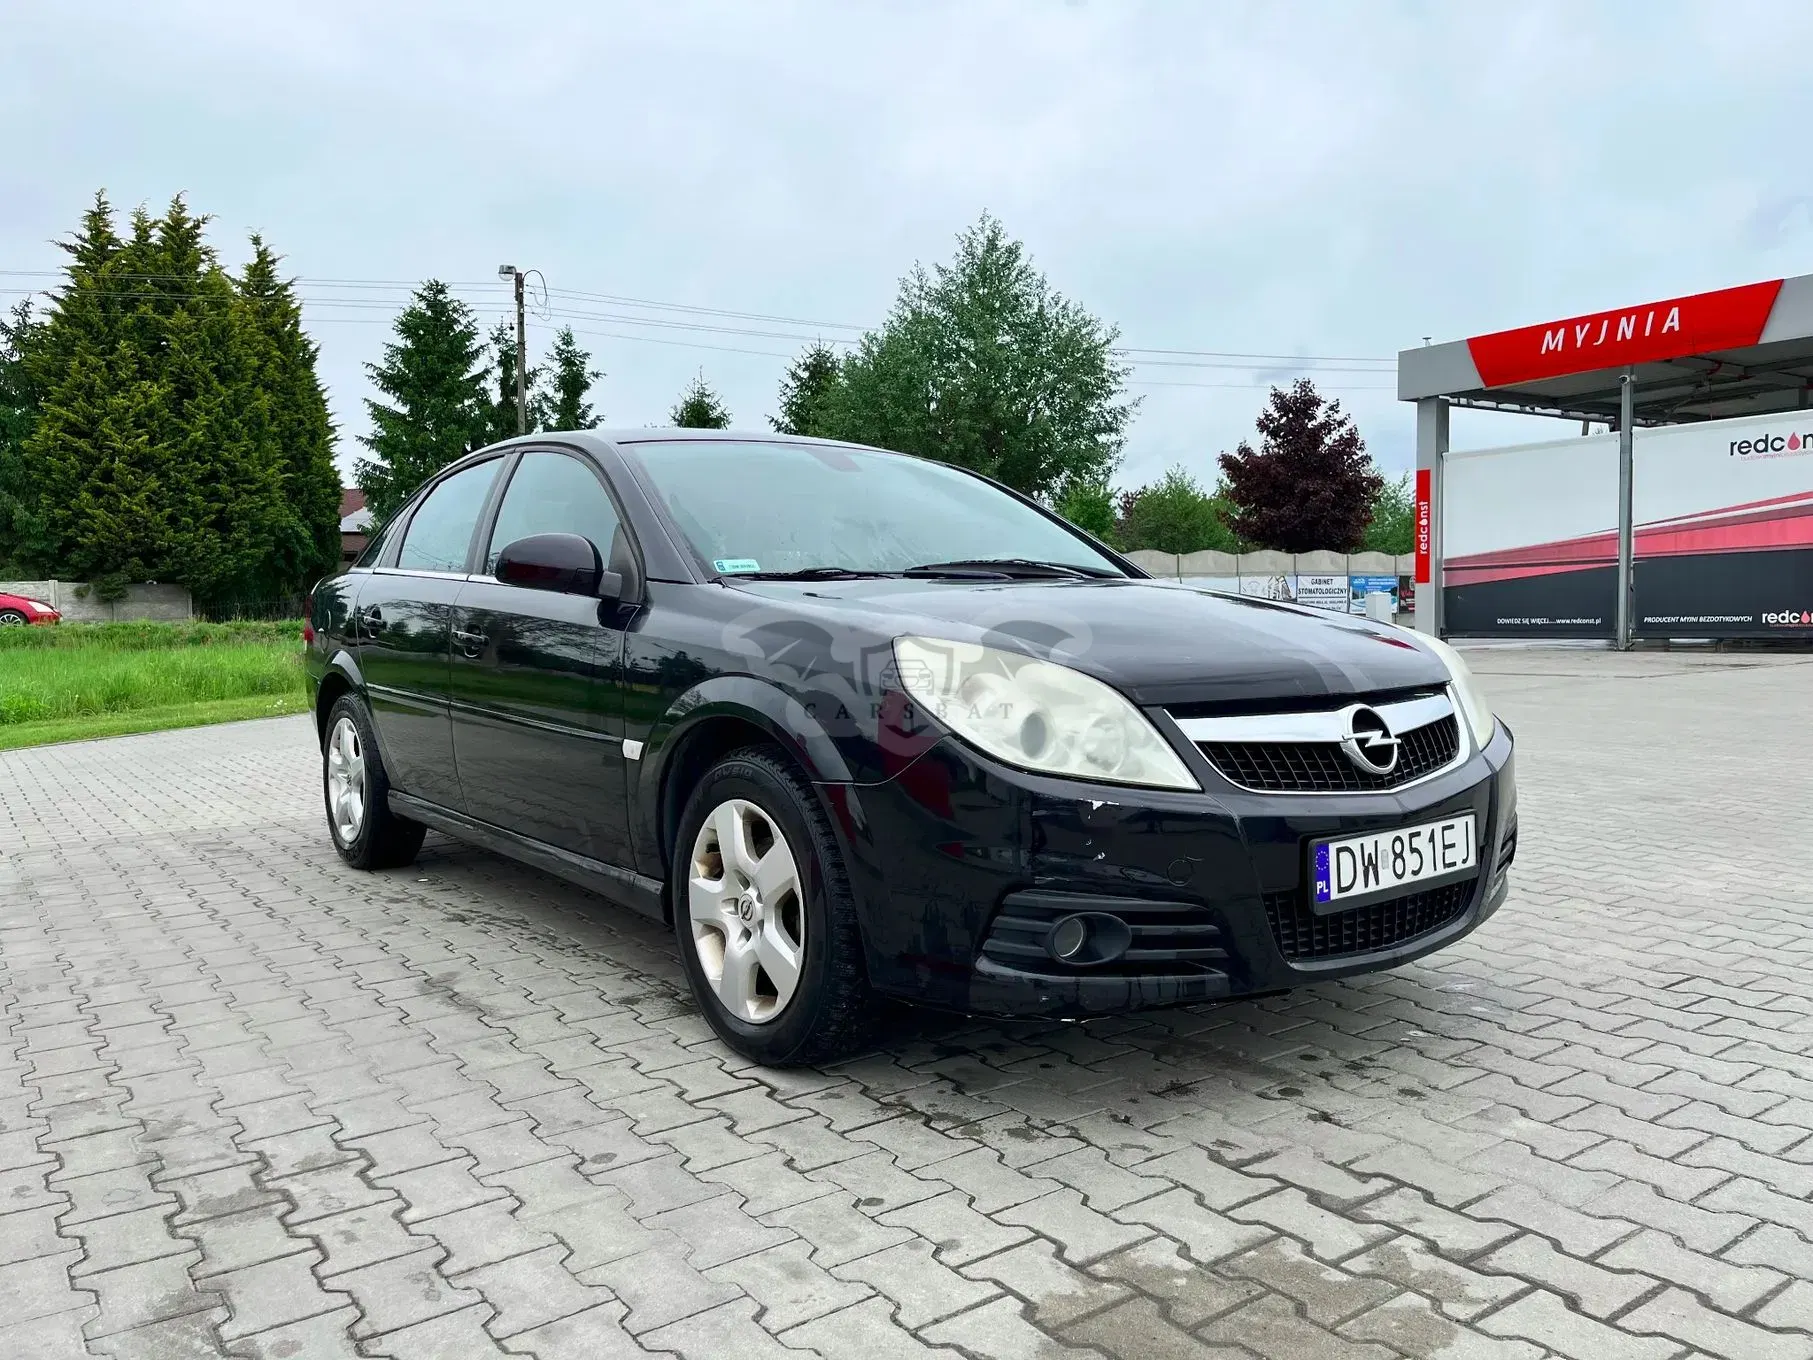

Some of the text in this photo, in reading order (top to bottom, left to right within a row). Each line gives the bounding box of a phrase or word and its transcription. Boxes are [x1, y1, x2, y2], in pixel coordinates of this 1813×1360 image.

[1540, 306, 1680, 355] MYJNIA
[1311, 578, 1334, 586] GABINET
[1298, 587, 1348, 596] STOMATOLOGICZNY
[1497, 617, 1521, 625] DOWIEDZ
[1699, 615, 1753, 623] BEZDOTYKOWYCH
[1335, 820, 1470, 894] DW 851EJ
[1316, 881, 1329, 895] PL
